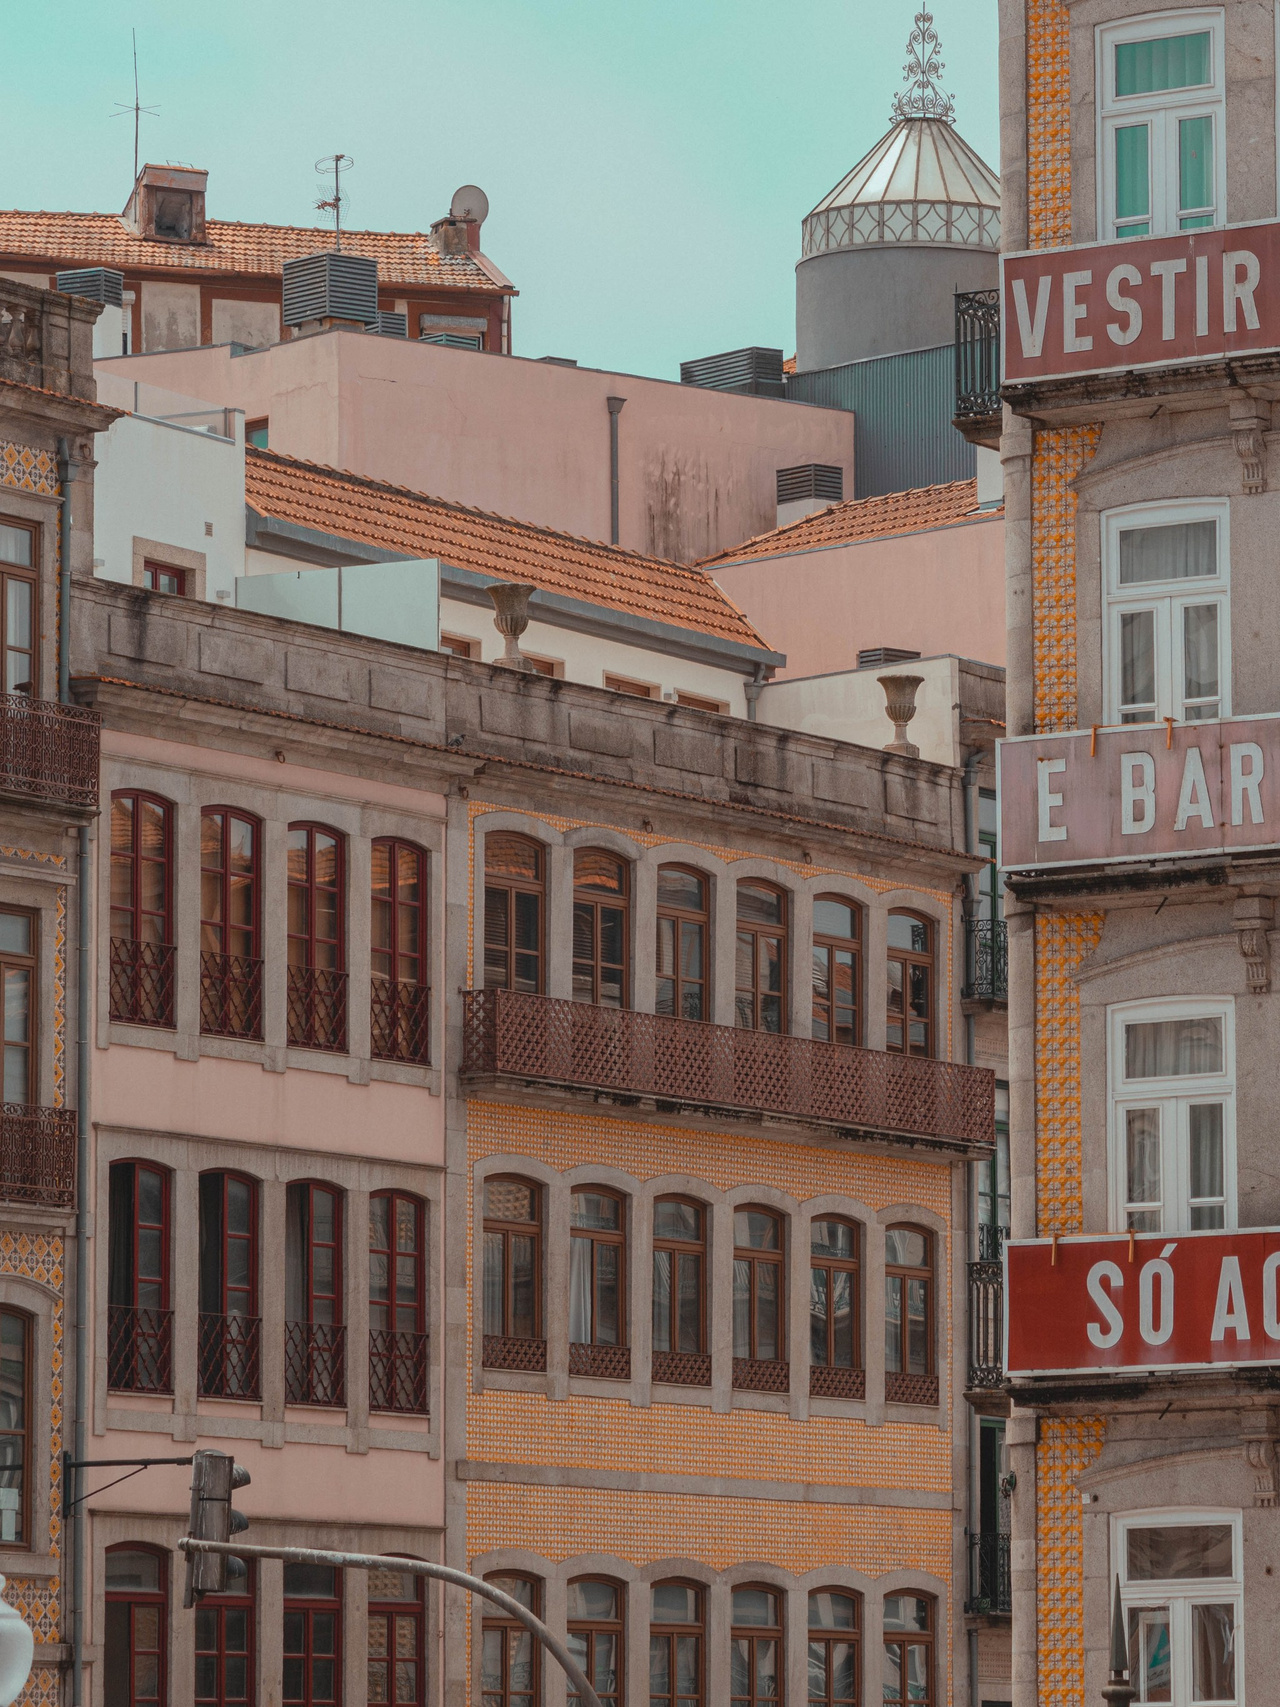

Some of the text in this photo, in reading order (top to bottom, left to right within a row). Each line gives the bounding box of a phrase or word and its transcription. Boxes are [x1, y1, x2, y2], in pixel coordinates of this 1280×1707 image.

[1011, 249, 1261, 359] VESTIR
[1036, 757, 1068, 843] E
[1086, 1243, 1178, 1349] SÓ
